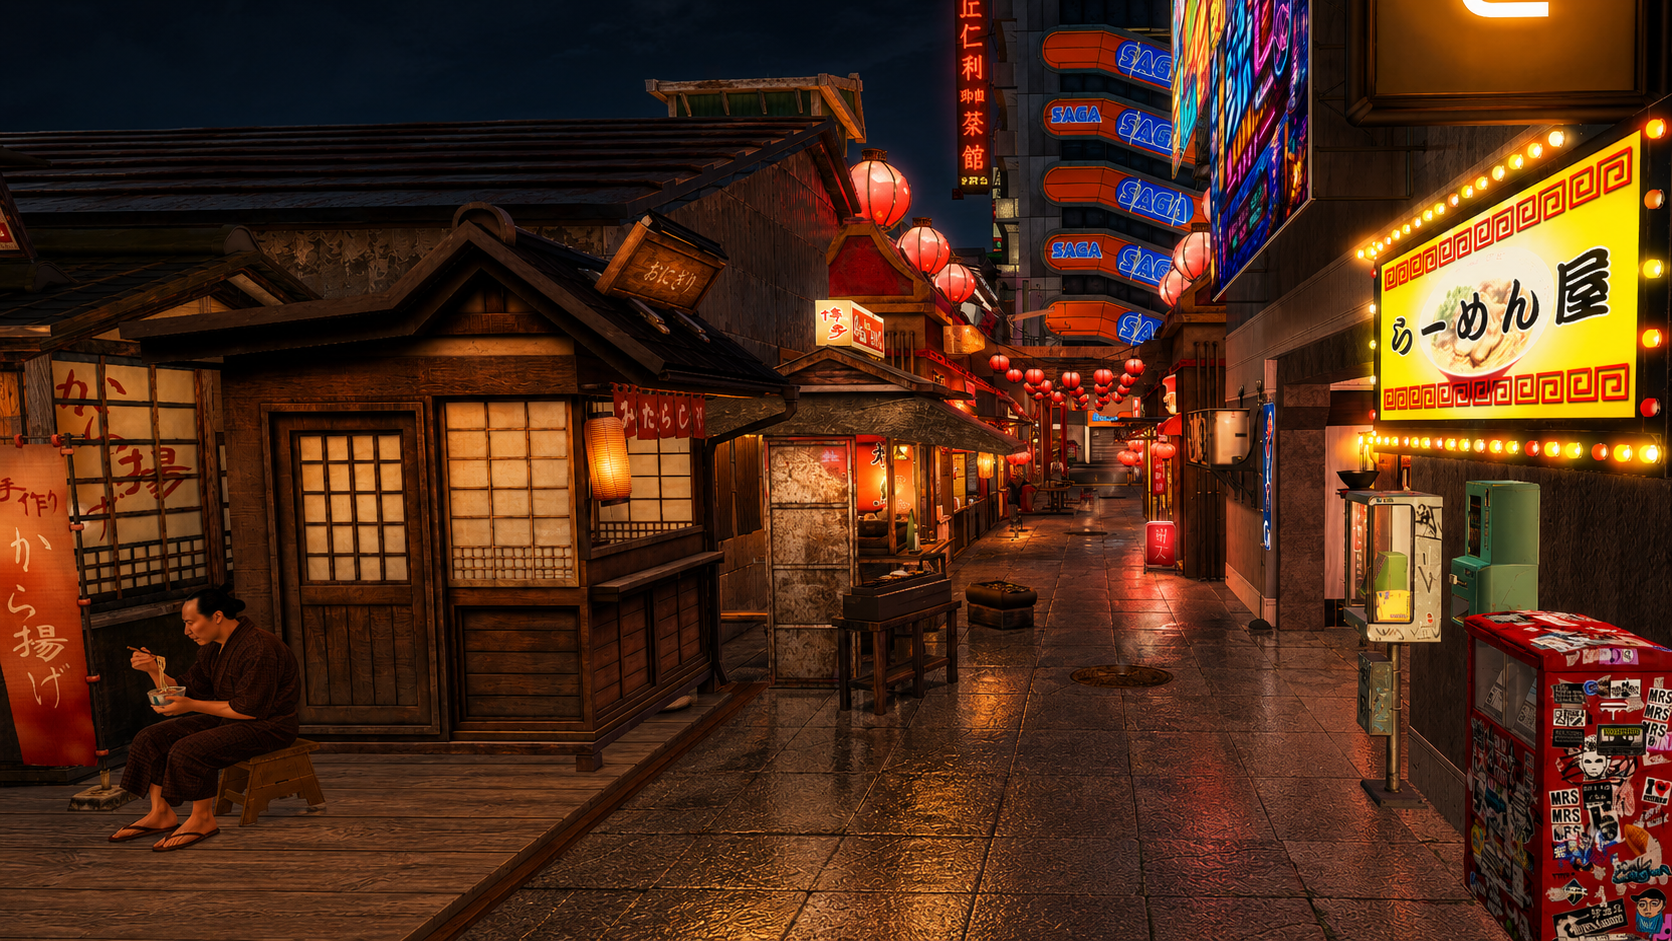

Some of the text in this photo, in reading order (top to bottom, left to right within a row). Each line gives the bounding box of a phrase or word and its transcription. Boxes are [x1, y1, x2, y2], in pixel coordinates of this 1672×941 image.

[1118, 44, 1172, 82] SAG
[1051, 105, 1102, 123] SAGA
[1118, 113, 1173, 151] SAG
[1118, 180, 1187, 224] SAGA
[1051, 241, 1103, 259] SAGA
[643, 261, 697, 295] おにぎり
[1391, 246, 1611, 356] らーめん屋
[0, 477, 58, 518] 手作り
[7, 526, 70, 710] から揚げ
[1644, 704, 1670, 721] MRS
[1649, 689, 1672, 705] MRS
[1550, 790, 1579, 805] MRS
[1552, 808, 1580, 823] MRS
